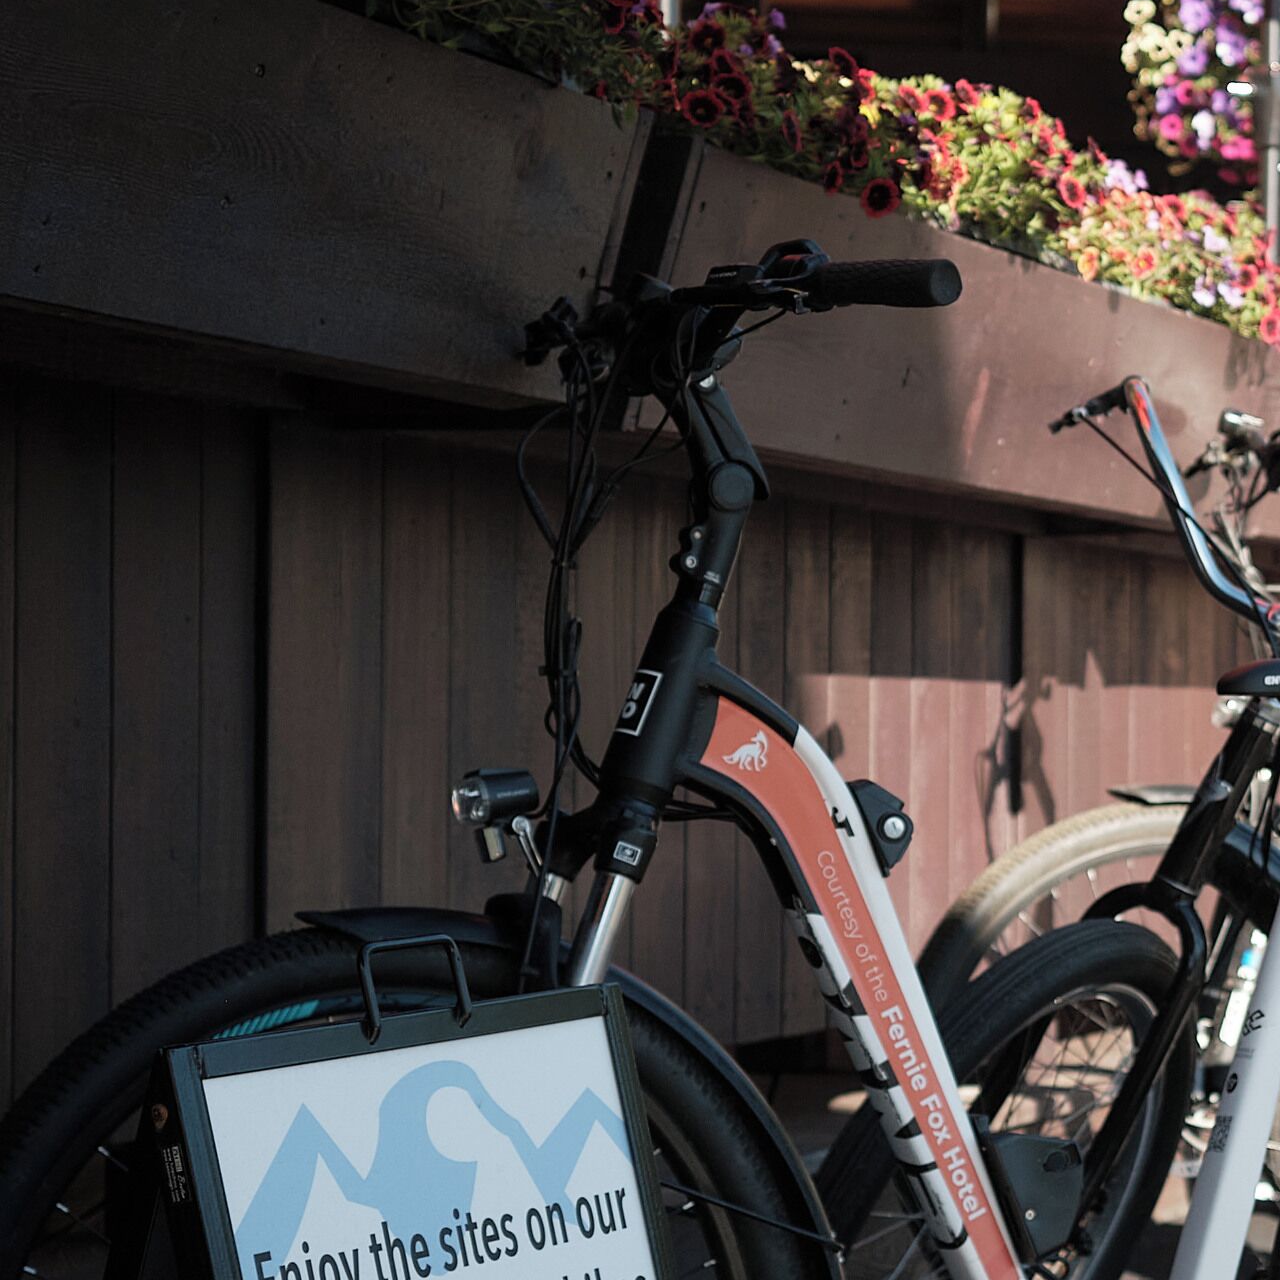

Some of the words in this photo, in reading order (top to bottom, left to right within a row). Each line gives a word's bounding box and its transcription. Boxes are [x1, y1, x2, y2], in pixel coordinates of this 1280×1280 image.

[817, 850, 863, 939] Courtesy
[855, 943, 878, 964] of
[865, 968, 888, 1003] the
[881, 1004, 928, 1093] Fernie
[919, 1093, 952, 1146] Fox
[942, 1146, 988, 1221] Hotel
[438, 1207, 519, 1272] sites
[526, 1202, 569, 1251] on
[575, 1187, 630, 1239] our
